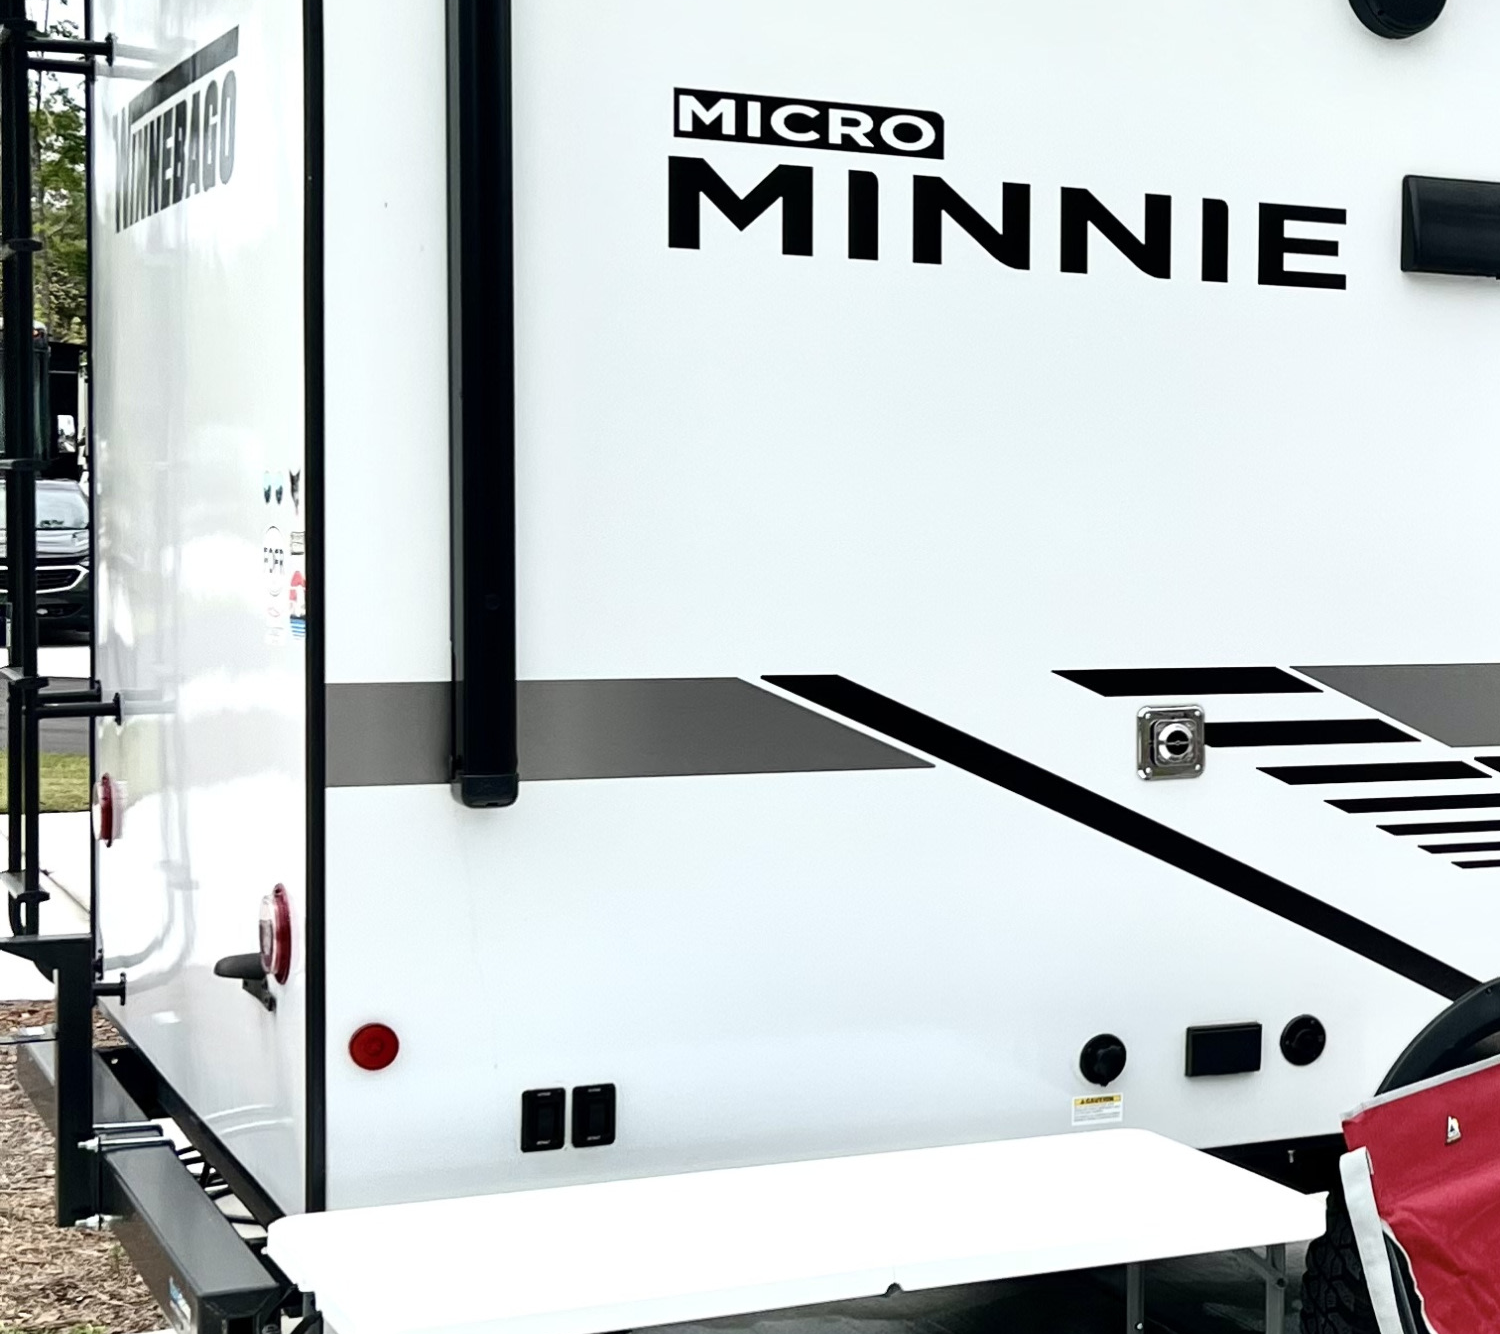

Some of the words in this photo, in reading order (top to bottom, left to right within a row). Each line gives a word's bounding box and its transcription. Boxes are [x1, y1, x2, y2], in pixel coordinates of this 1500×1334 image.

[112, 69, 238, 234] WINNEBAGO
[678, 94, 937, 152] MICRO
[668, 155, 1348, 291] MINNIE
